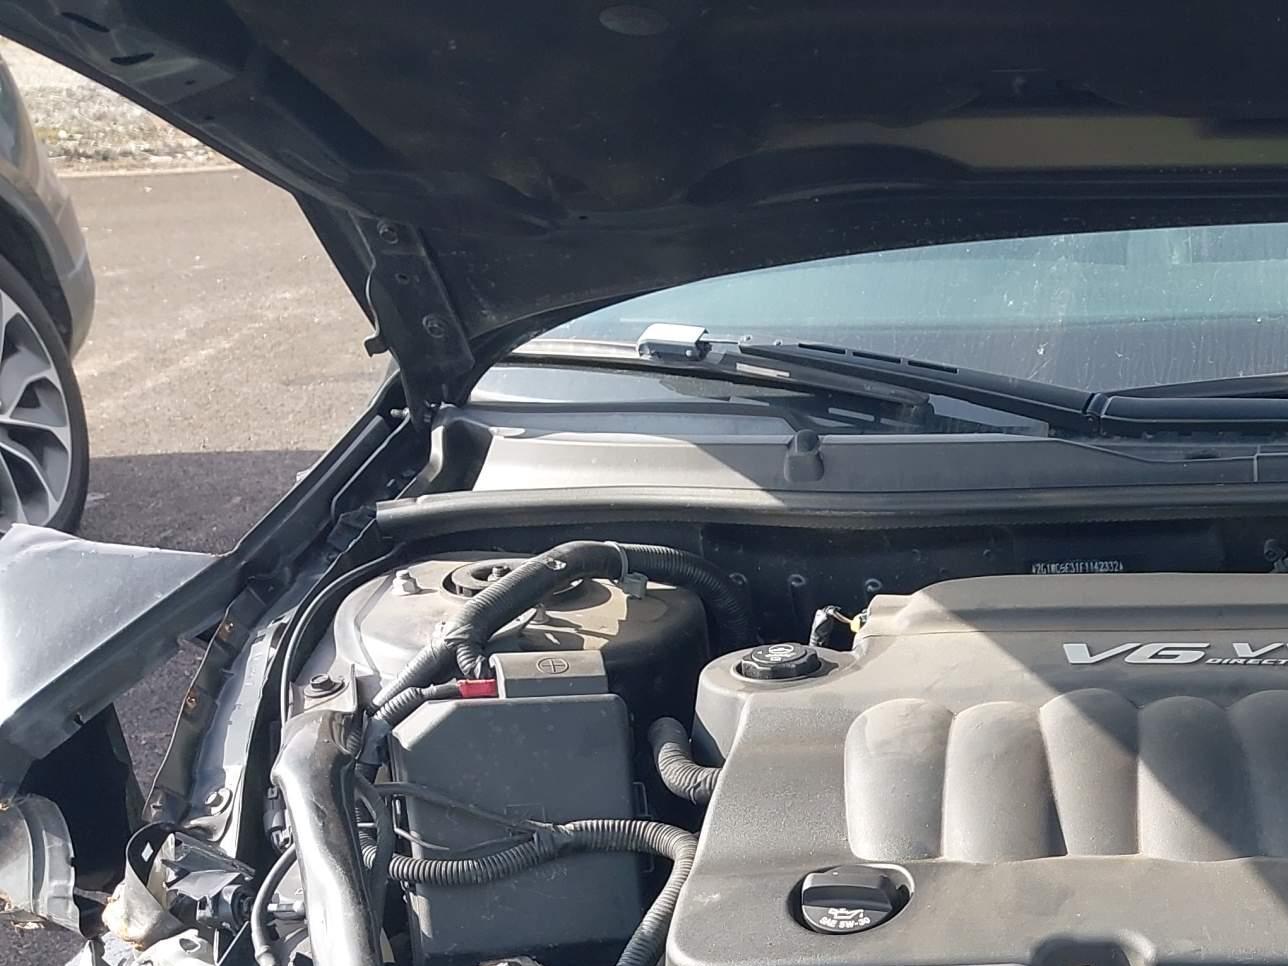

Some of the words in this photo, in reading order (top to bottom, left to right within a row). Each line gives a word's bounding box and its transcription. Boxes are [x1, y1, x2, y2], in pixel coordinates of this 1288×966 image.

[1062, 642, 1211, 665] V6
[820, 917, 837, 928] SAE
[839, 917, 870, 928] 5W-30
